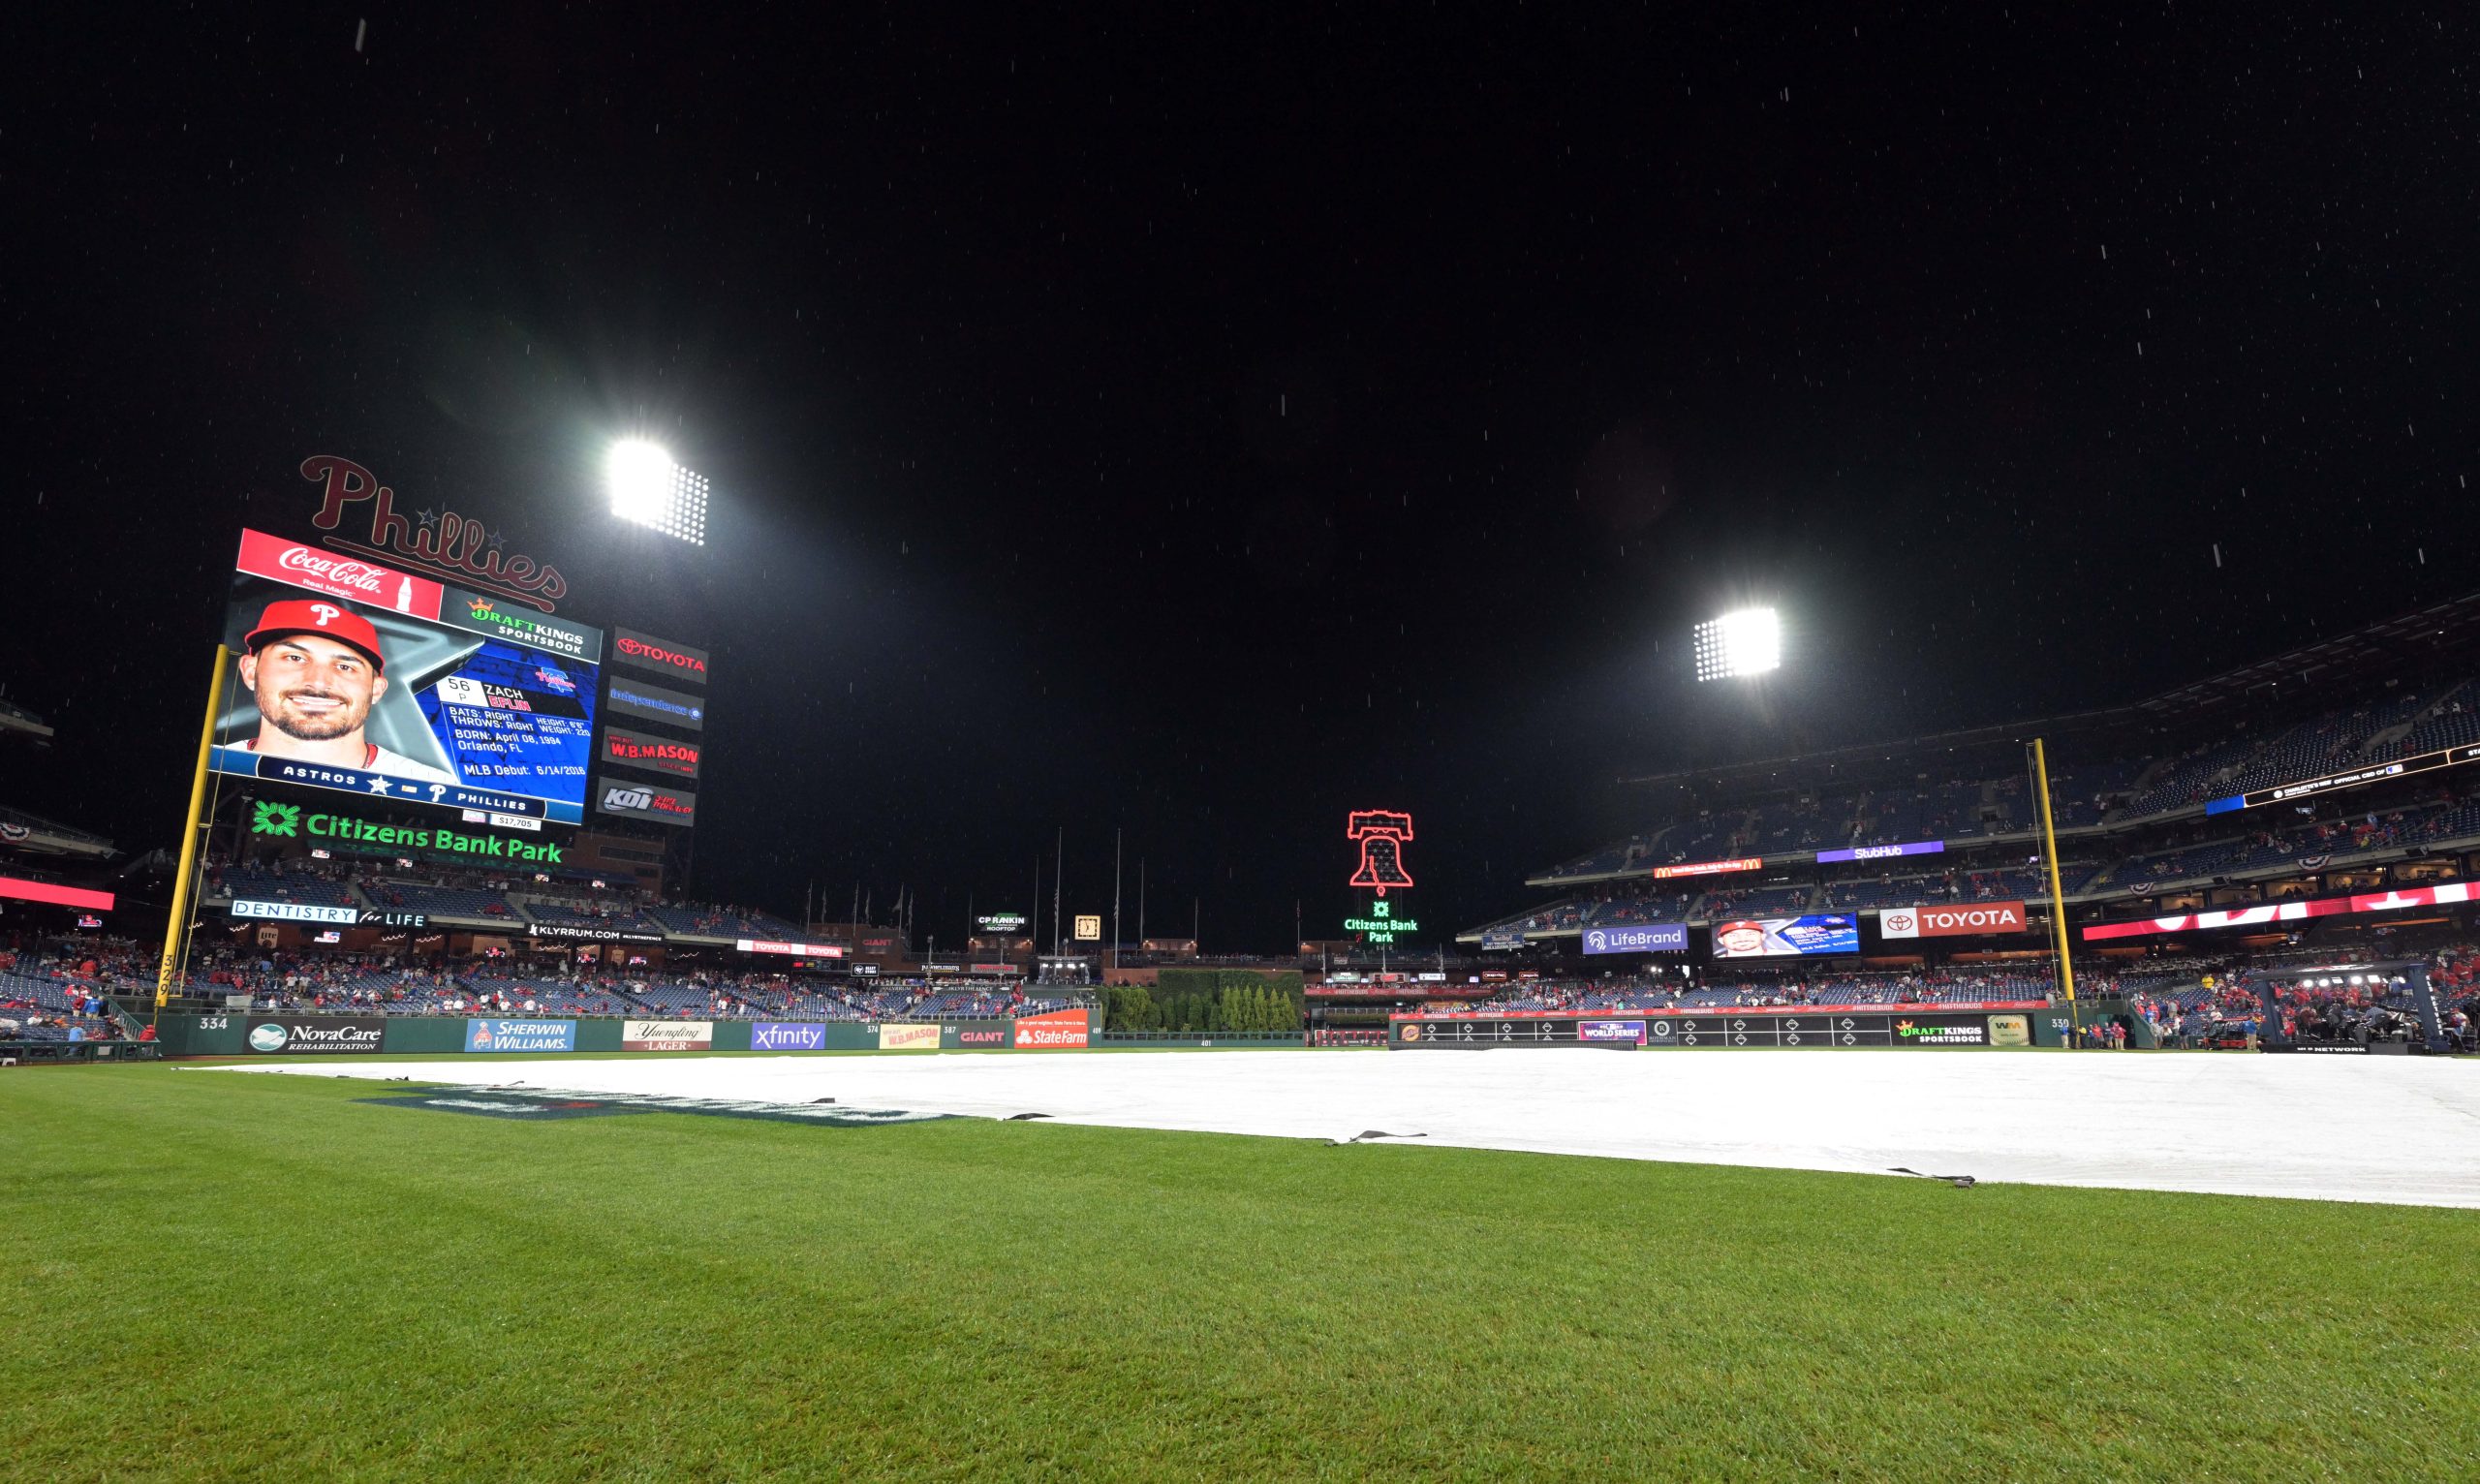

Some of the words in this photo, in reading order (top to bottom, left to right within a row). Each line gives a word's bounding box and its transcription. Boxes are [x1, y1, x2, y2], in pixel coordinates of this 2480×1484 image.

[300, 455, 567, 599] Phillies
[279, 547, 388, 593] Coca-Cola
[303, 578, 324, 590] Real
[471, 608, 583, 645] DRAFTKINGS
[498, 626, 581, 654] SPORTSBOOK
[640, 643, 705, 673] TOYOTA
[449, 678, 470, 692] 56
[484, 684, 523, 699] ZACH
[459, 693, 467, 701] P
[449, 706, 481, 719] BATS:
[485, 711, 514, 722] RIGHT
[450, 715, 504, 728] THROWS:
[507, 722, 534, 731] RIGHT
[536, 717, 568, 727] HEIGHT:
[454, 728, 491, 741] BORN:
[495, 732, 519, 744] April
[540, 725, 574, 735] WEIGHT:
[457, 740, 508, 754] Orlando,
[510, 744, 523, 753] FL
[464, 764, 490, 776] MLB
[494, 764, 531, 776] Debut:
[284, 765, 356, 786] ASTROS
[457, 793, 527, 811] PHILLIES
[307, 814, 429, 848] Citizens
[436, 829, 507, 856] Bank
[509, 838, 563, 864] Park
[1854, 847, 1903, 859] StubHub
[235, 902, 353, 922] DENTISTRY
[359, 911, 382, 923] for
[386, 912, 424, 927] LIFE
[1923, 909, 2017, 929] TOYOTA
[1345, 919, 1388, 930] Citizens
[1390, 919, 1418, 931] Bank
[539, 926, 620, 940] KLYRRUM.COM
[1369, 931, 1393, 943] Park
[1611, 929, 1682, 946] LifeBrand
[755, 943, 790, 952] TOYOTA
[808, 946, 839, 956] TOYOTA
[200, 1017, 228, 1030] 334
[496, 1021, 567, 1036] SHERWIN
[867, 1025, 878, 1034] 374
[289, 1025, 381, 1041] NovaCare
[635, 1022, 701, 1041] Yuengling
[756, 1025, 822, 1049] xfinity
[960, 1032, 1005, 1042] GIANT
[1899, 1027, 1982, 1037] DRAFTKINGS
